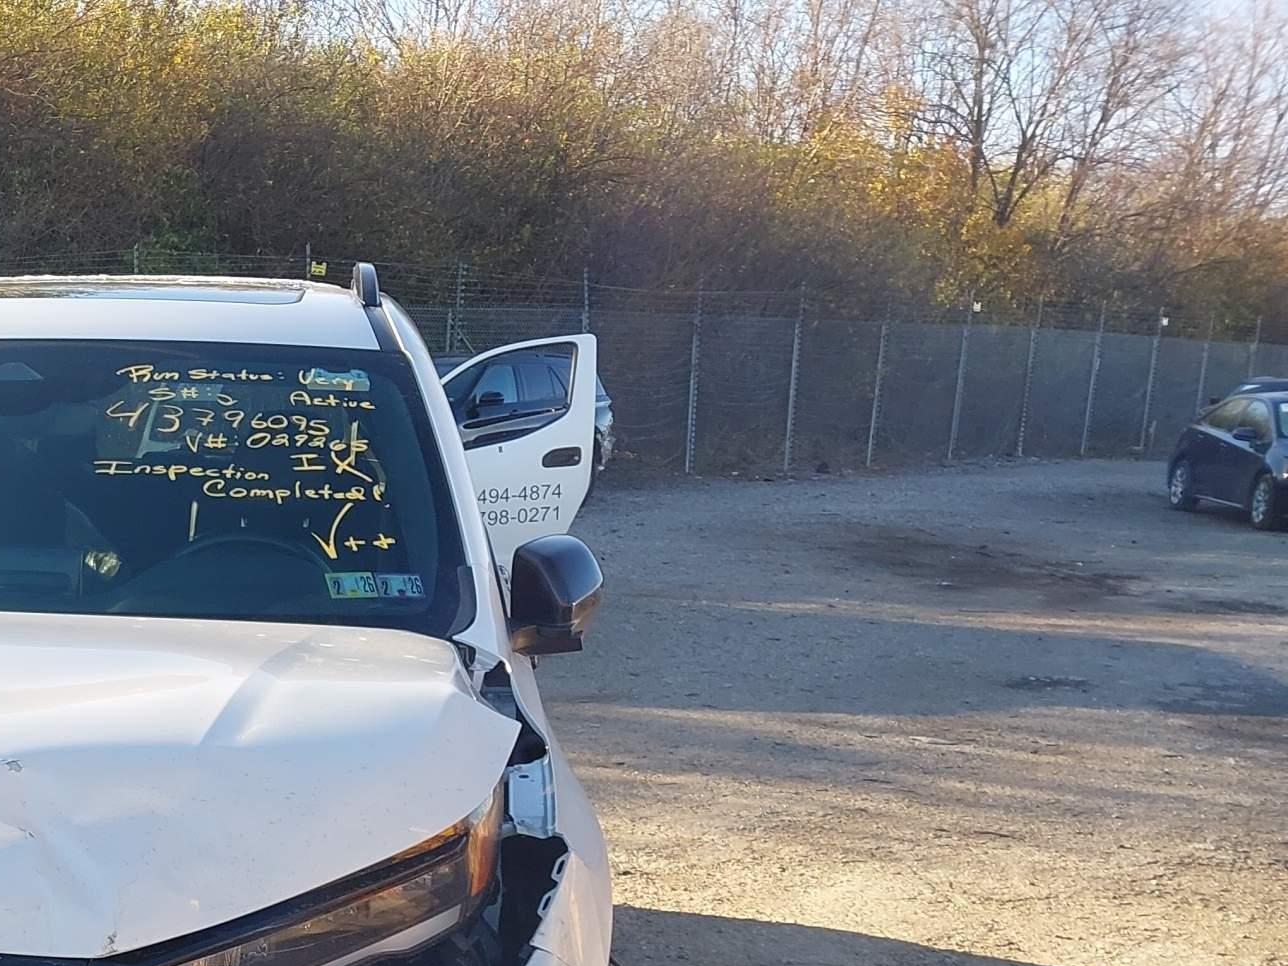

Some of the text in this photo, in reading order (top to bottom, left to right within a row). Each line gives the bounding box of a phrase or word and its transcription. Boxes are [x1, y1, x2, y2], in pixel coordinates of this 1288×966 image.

[115, 364, 180, 383] Run
[298, 367, 354, 391] Very
[289, 390, 377, 410] Active
[105, 400, 330, 435] 43796095
[93, 460, 270, 481] Inspection
[477, 483, 562, 505] 494-4874
